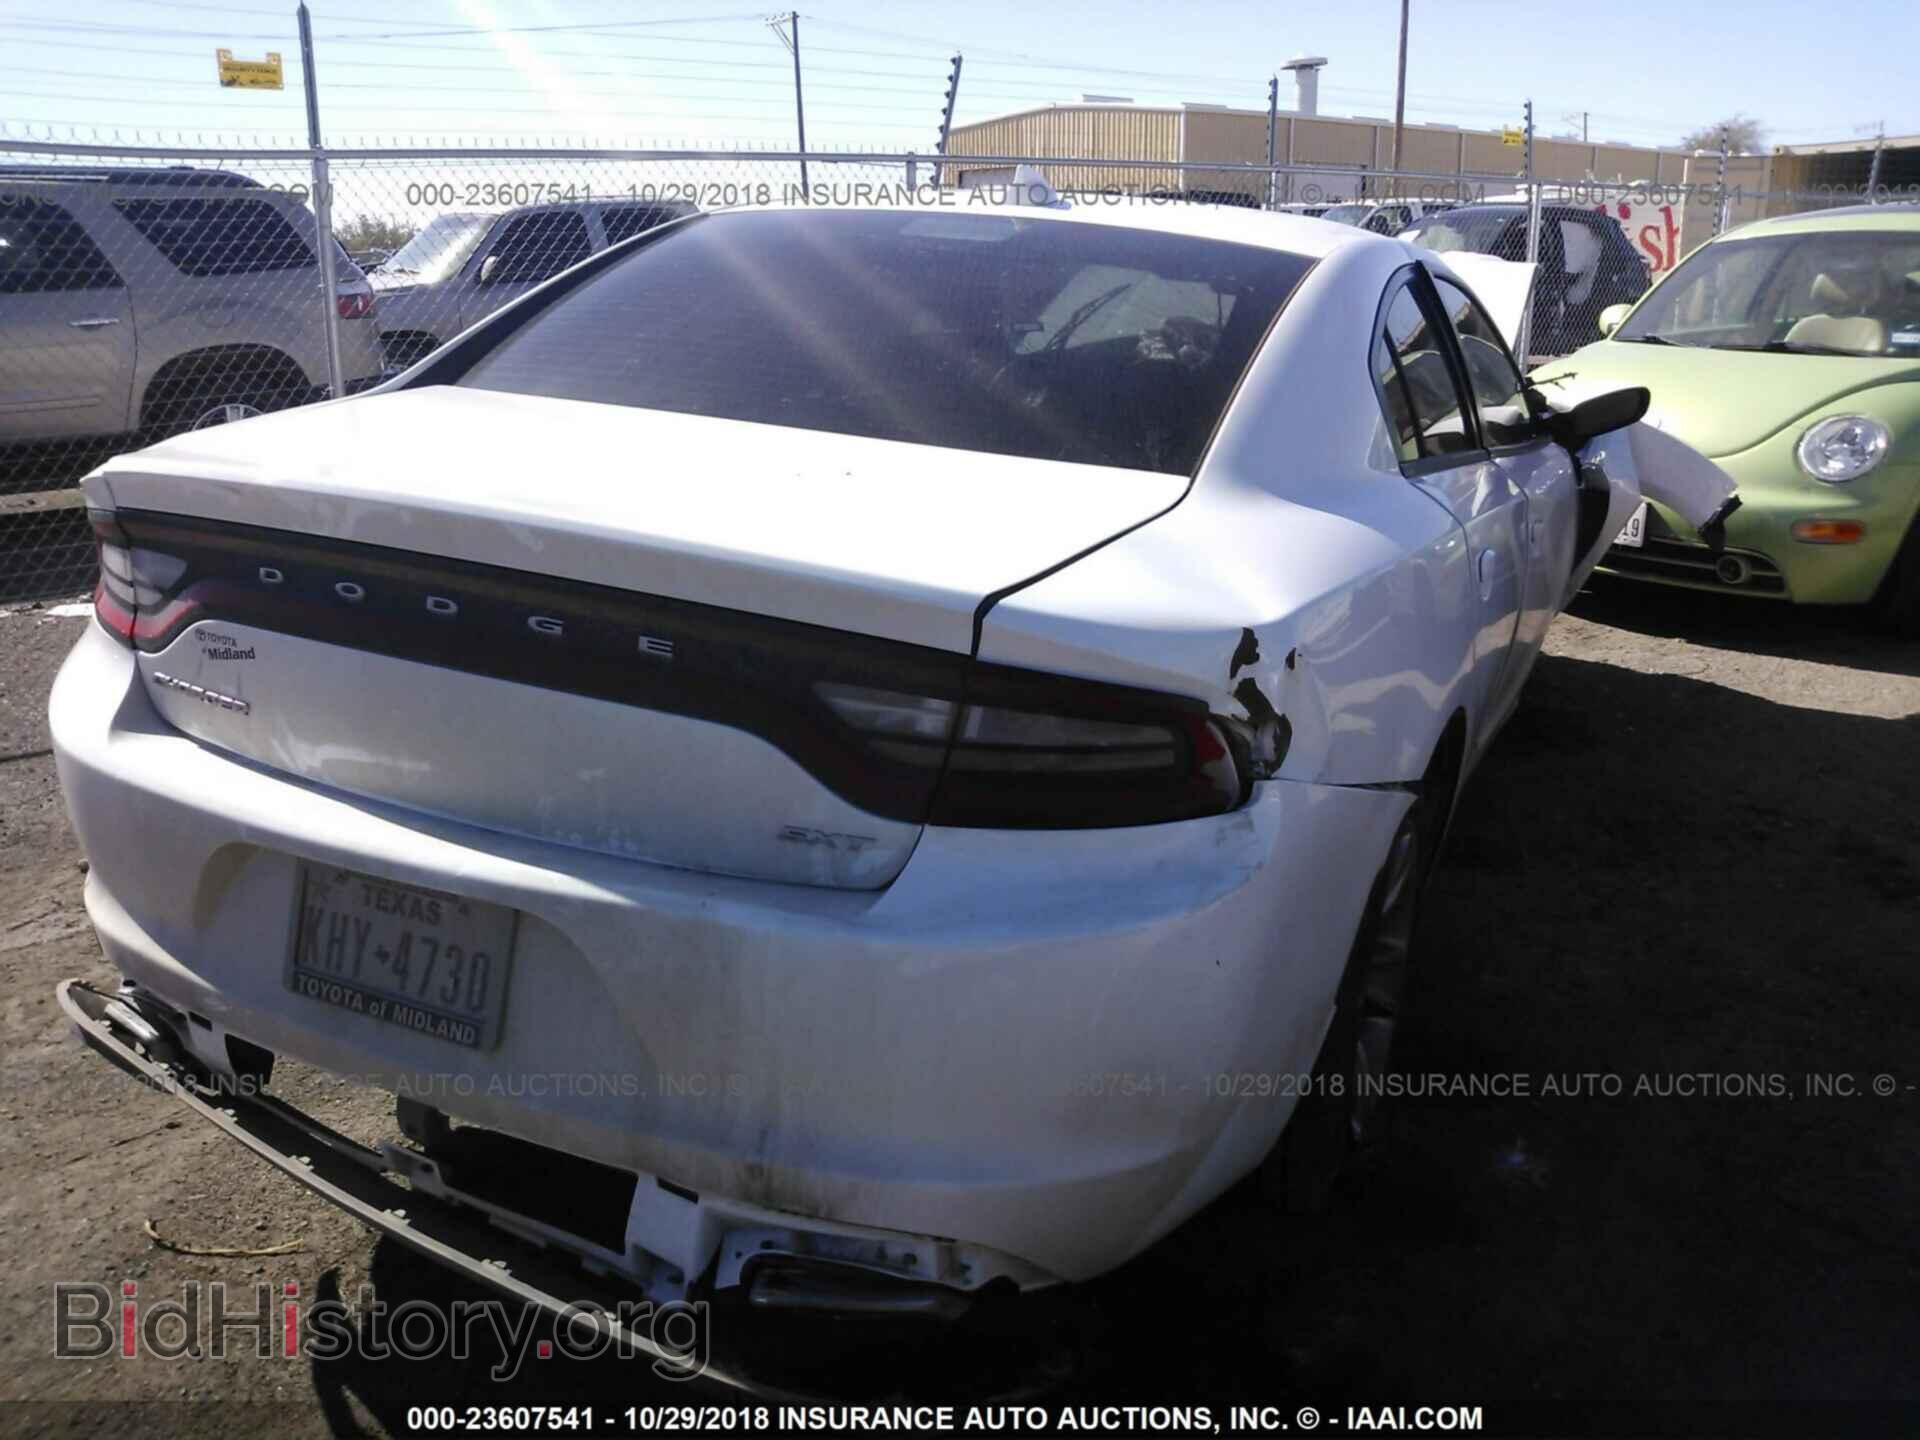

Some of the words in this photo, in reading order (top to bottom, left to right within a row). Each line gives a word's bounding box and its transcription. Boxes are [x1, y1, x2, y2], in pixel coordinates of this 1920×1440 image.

[259, 567, 674, 658] DODGE
[207, 647, 256, 661] Midland
[362, 883, 441, 927] TEXAS
[298, 974, 364, 1012] TOYOTA
[368, 999, 388, 1018] of
[392, 1003, 477, 1046] MIDLAND
